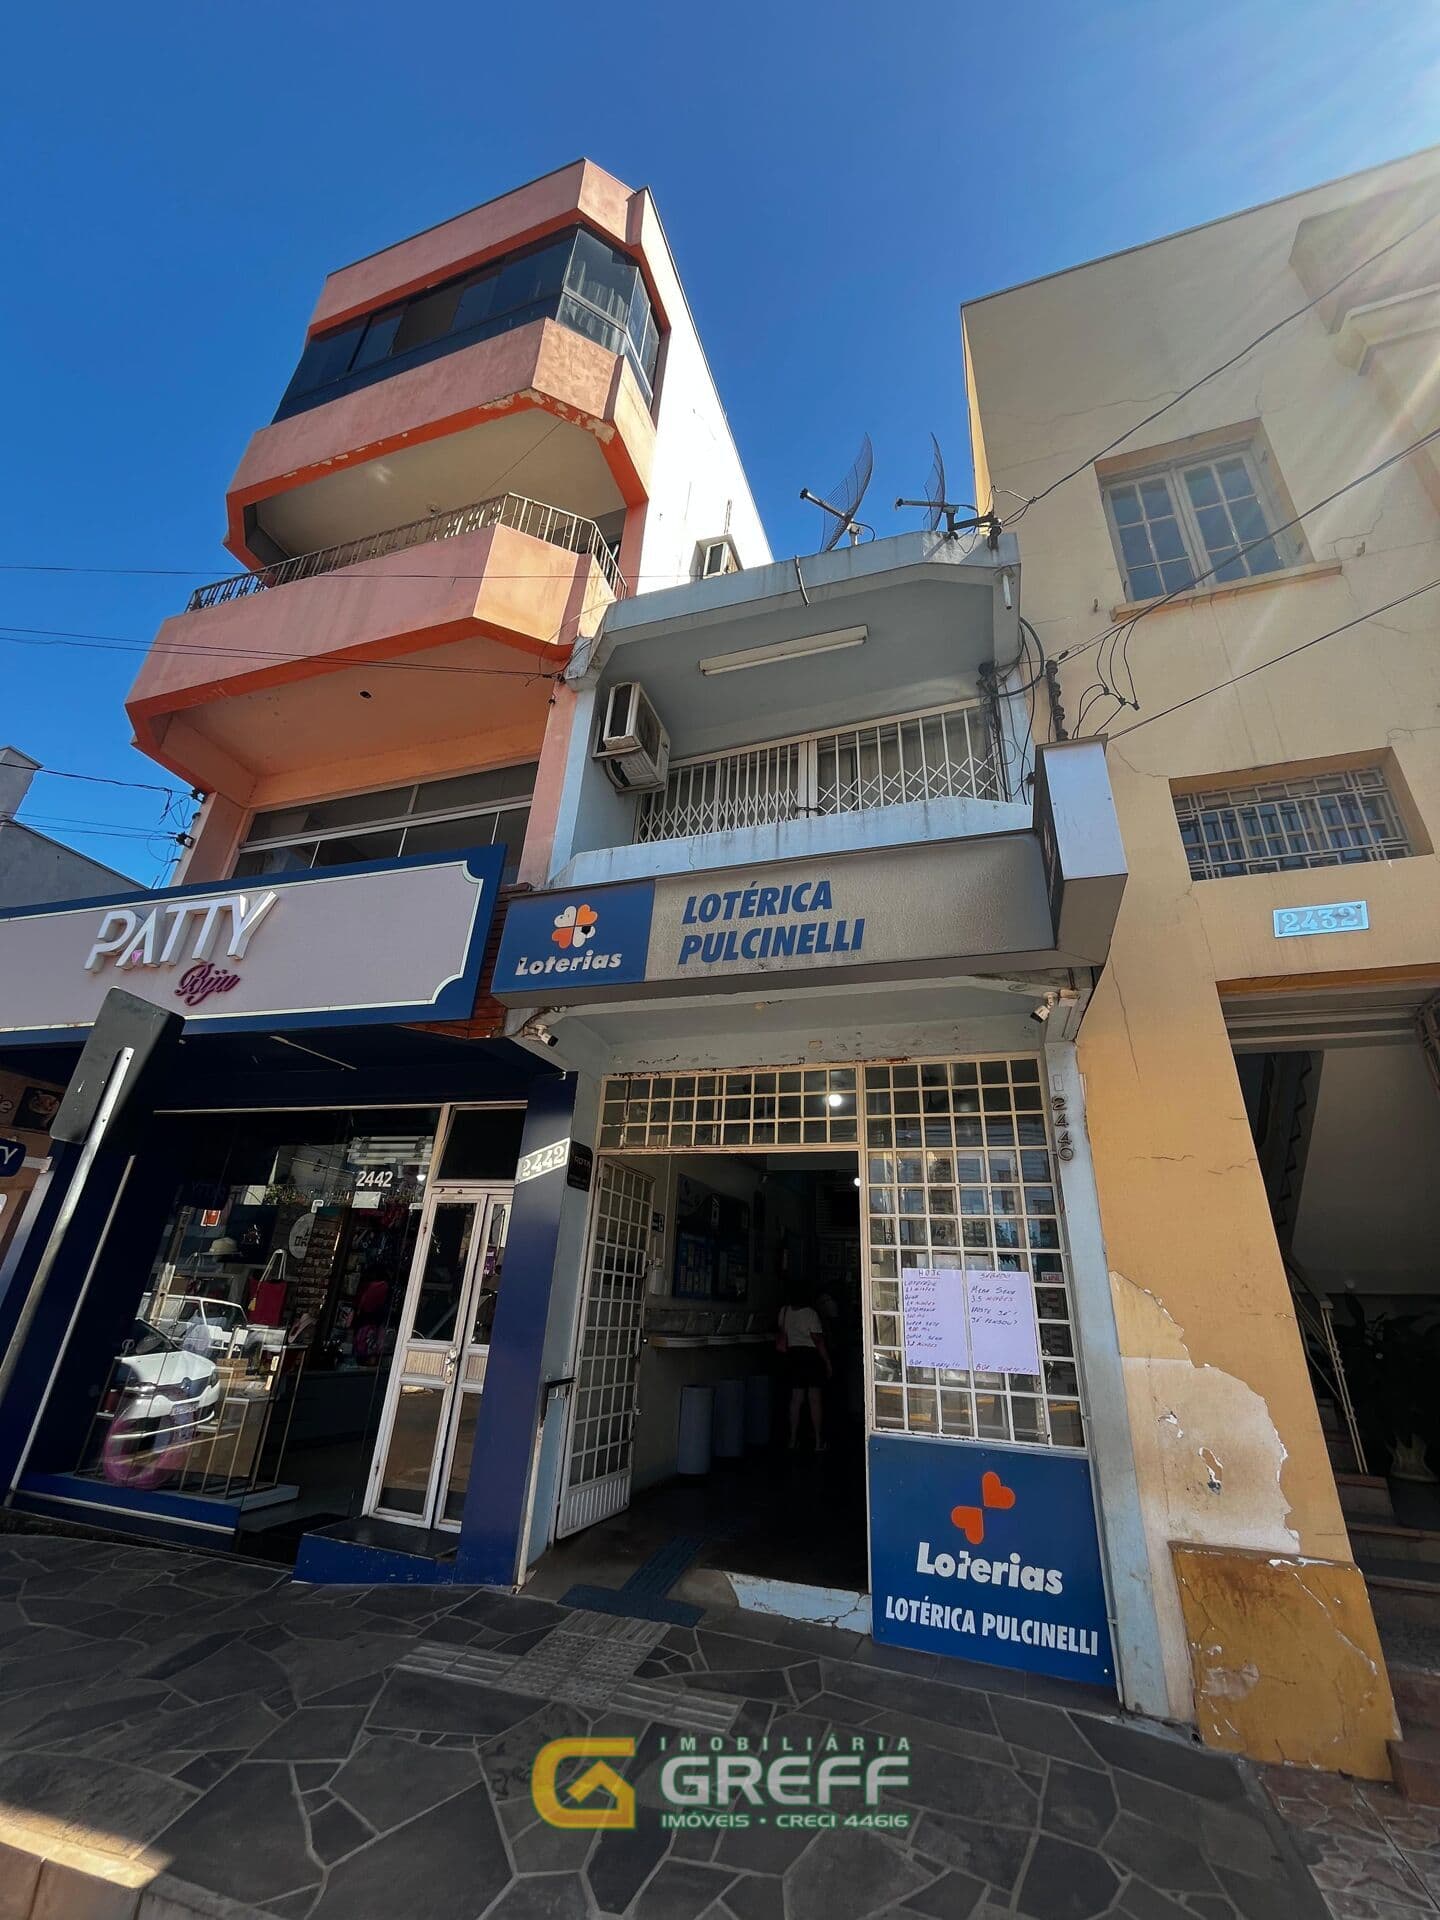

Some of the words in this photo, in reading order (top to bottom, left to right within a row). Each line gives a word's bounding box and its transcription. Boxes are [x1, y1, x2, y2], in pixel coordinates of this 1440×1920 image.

[682, 880, 833, 925] LOTÉRICA
[1281, 905, 1359, 934] 2432
[84, 891, 279, 974] PATTY
[678, 918, 866, 966] PULCINELLI
[515, 949, 623, 976] Loterias
[1051, 1096, 1074, 1161] 2440
[356, 1171, 393, 1188] 2442
[521, 1145, 565, 1177] 2442
[916, 1541, 1063, 1595] Loterias
[885, 1595, 976, 1635] LOTÉRICA
[982, 1612, 1098, 1656] PULCINELLI
